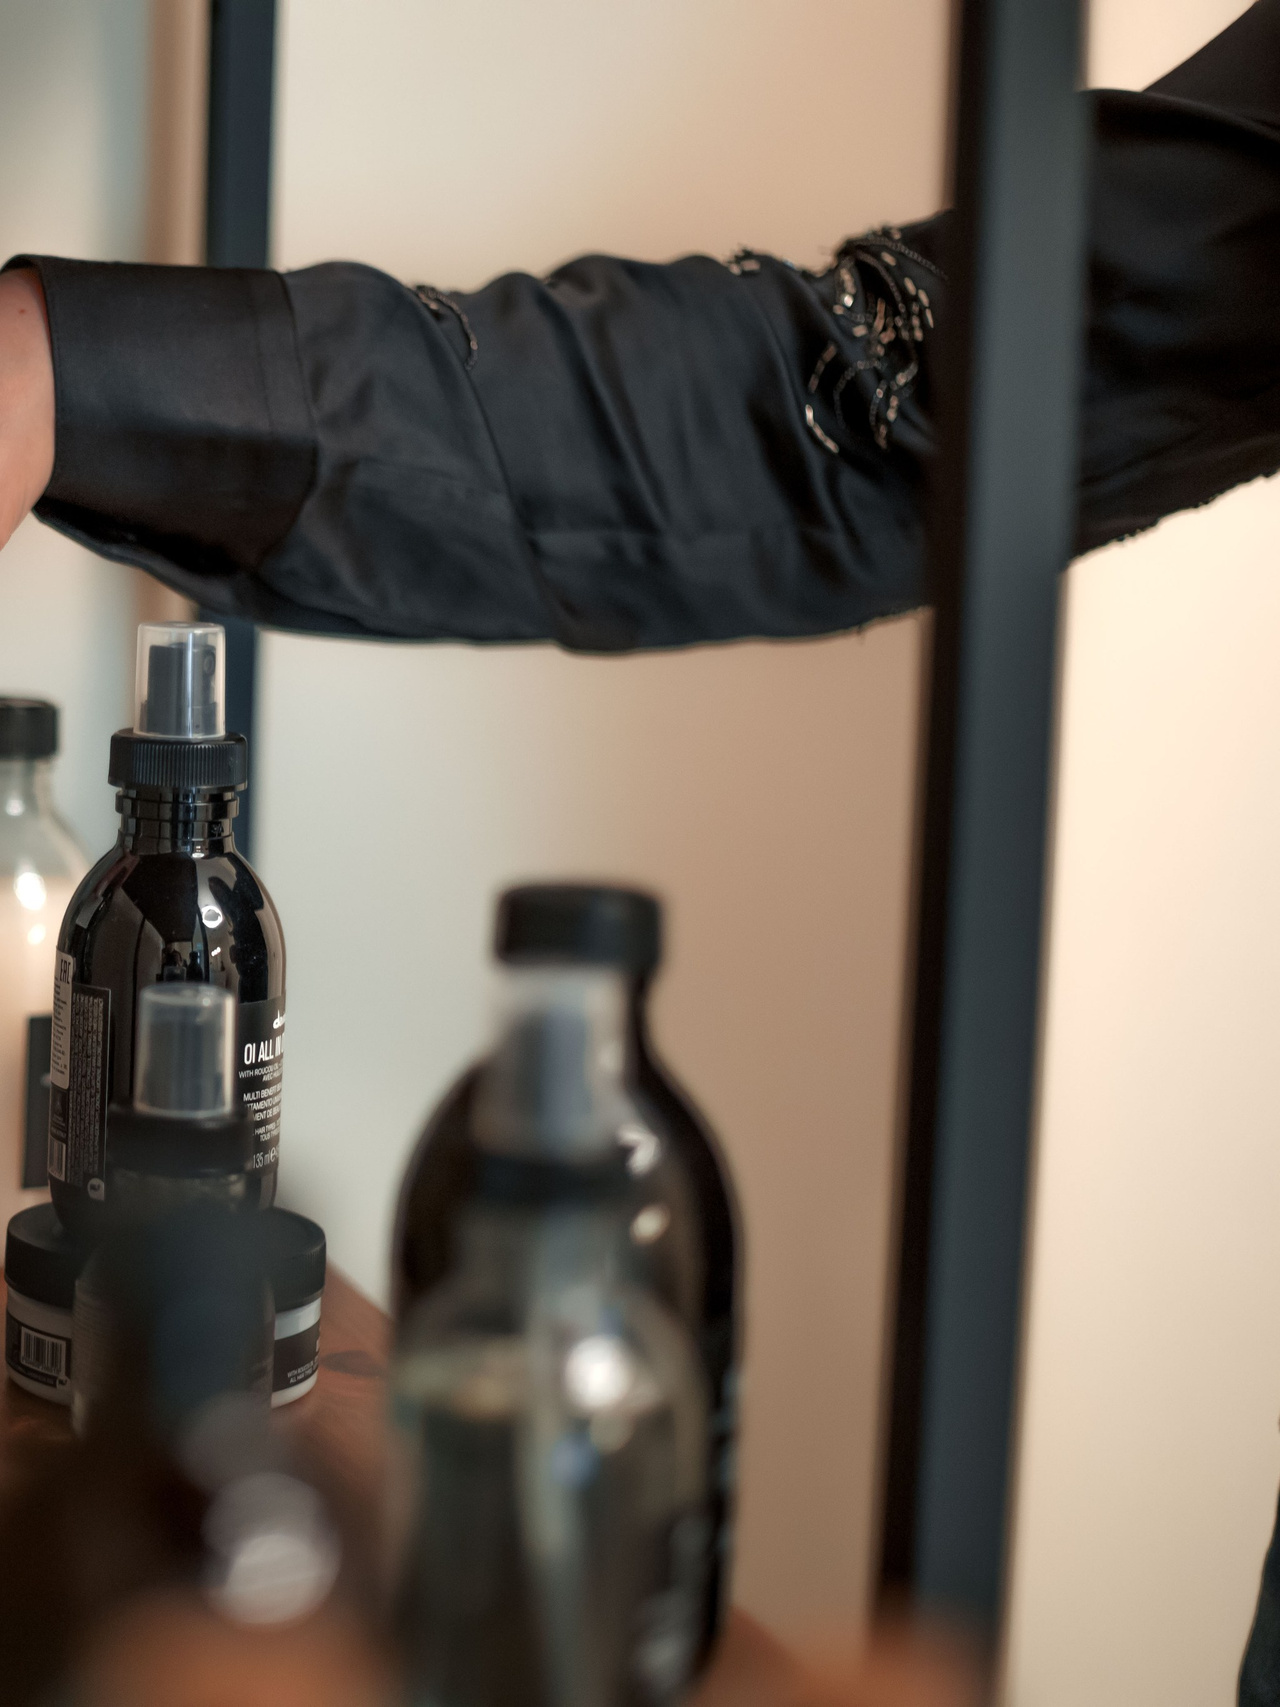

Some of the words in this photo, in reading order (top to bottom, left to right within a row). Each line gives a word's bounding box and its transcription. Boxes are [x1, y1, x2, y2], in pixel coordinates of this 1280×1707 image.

[244, 1043, 256, 1065] OI
[257, 1040, 274, 1063] ALL
[238, 1069, 254, 1079] WITH
[243, 1090, 260, 1102] MULTI
[253, 1151, 263, 1168] 135
